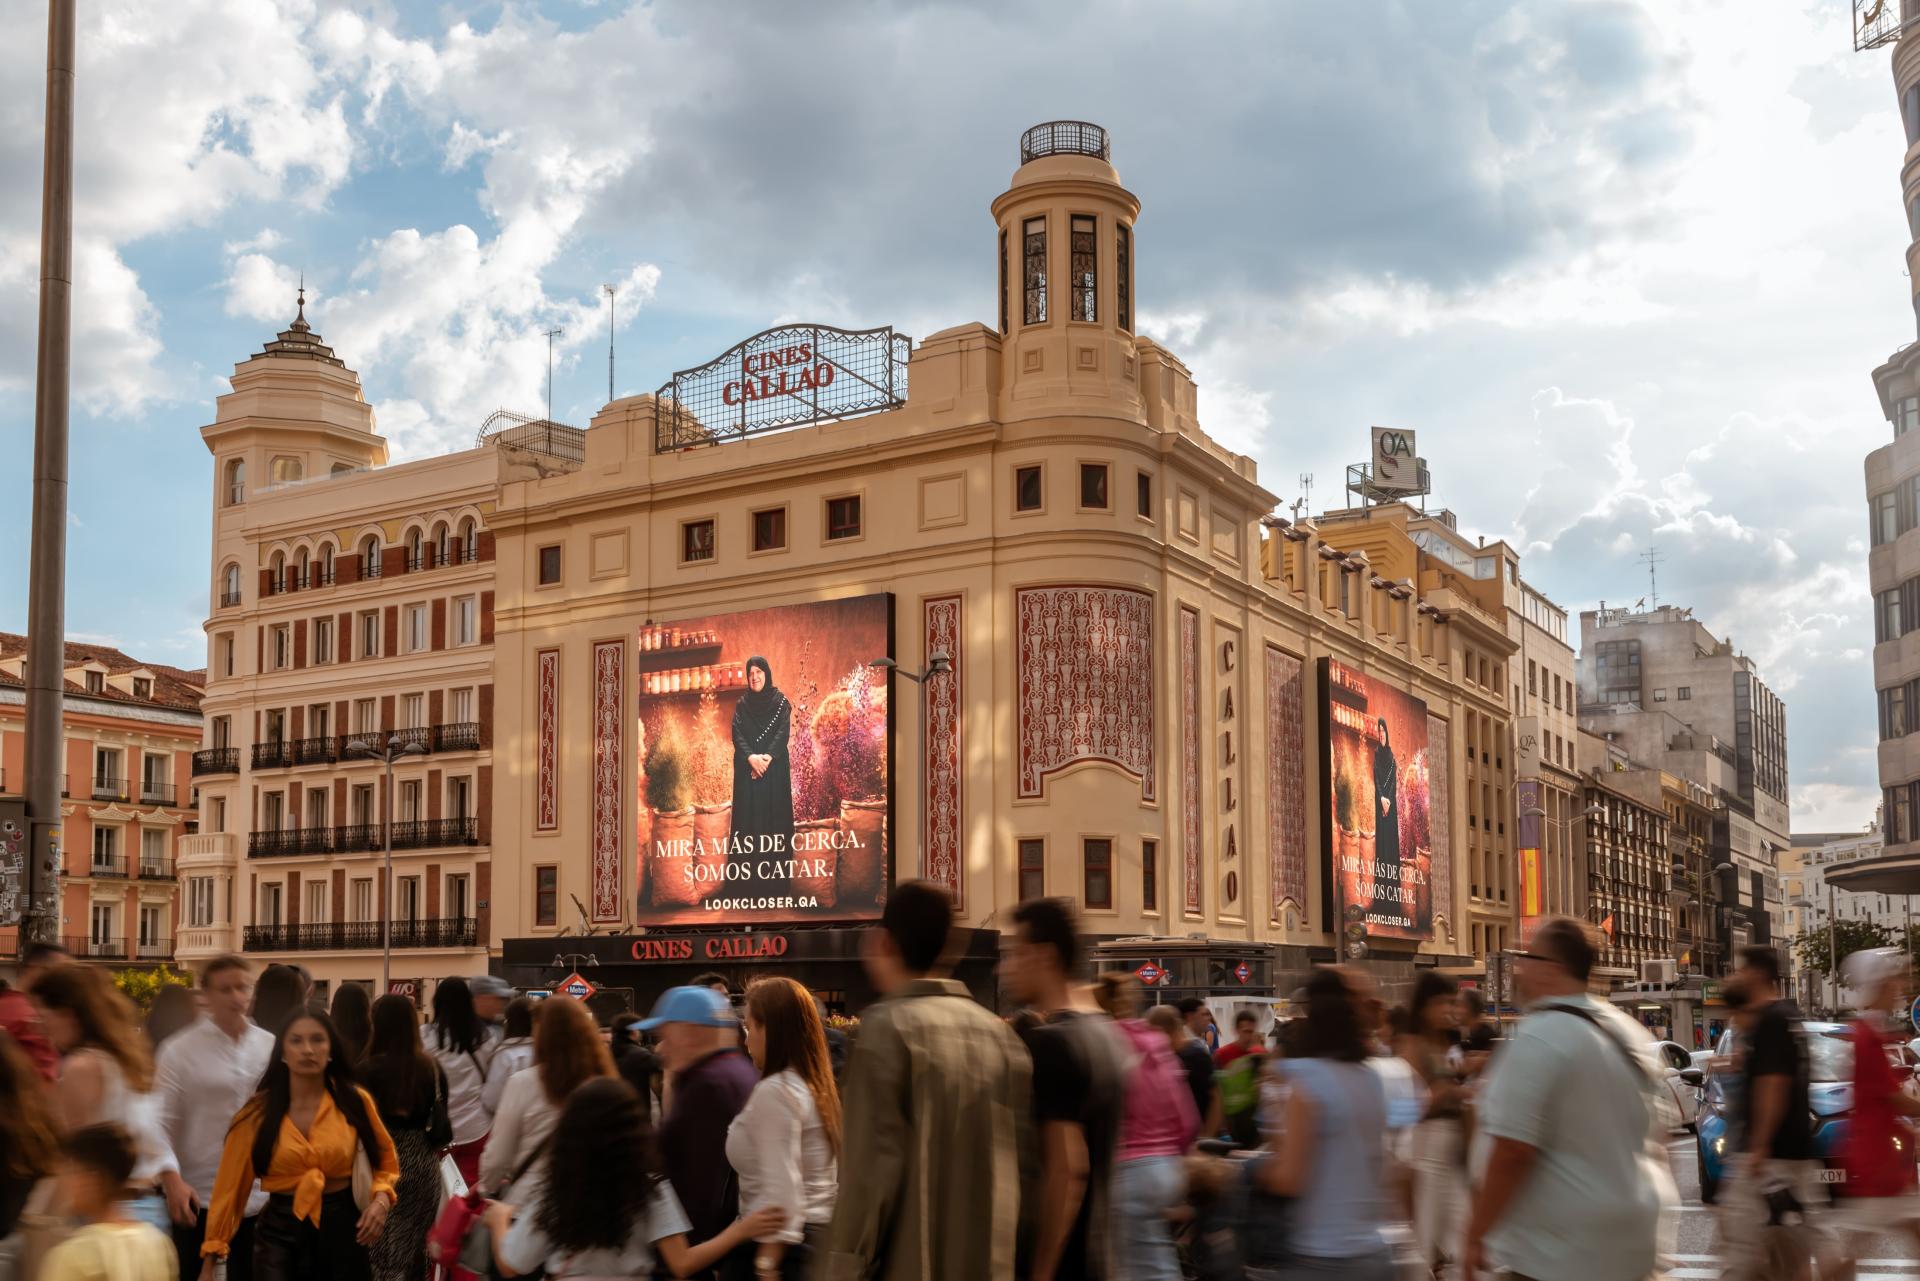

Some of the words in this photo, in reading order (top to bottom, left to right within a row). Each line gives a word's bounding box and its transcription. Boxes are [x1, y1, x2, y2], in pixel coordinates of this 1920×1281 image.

[743, 343, 811, 374] CINES
[723, 363, 834, 406] CALLAO
[1224, 640, 1238, 901] CALLAO
[656, 839, 705, 858] MIRA
[712, 831, 754, 855] MÁS
[760, 834, 786, 853] DE
[791, 830, 866, 851] CERCA.
[684, 862, 751, 883] SOMOS
[757, 859, 833, 879] CATAR.
[1342, 855, 1365, 875] MIRA
[1368, 858, 1386, 878] MÁS
[1387, 863, 1398, 880] DE
[1399, 866, 1426, 885] CERCA.
[705, 896, 818, 910] LOOKCLOSER.QA
[1355, 881, 1385, 900] SOMOS
[1386, 886, 1416, 904] CATAR.
[1365, 913, 1411, 927] LOOKCLOSER.QA
[632, 939, 693, 960] CINES
[705, 936, 788, 958] CALLAO
[569, 986, 586, 994] Metro
